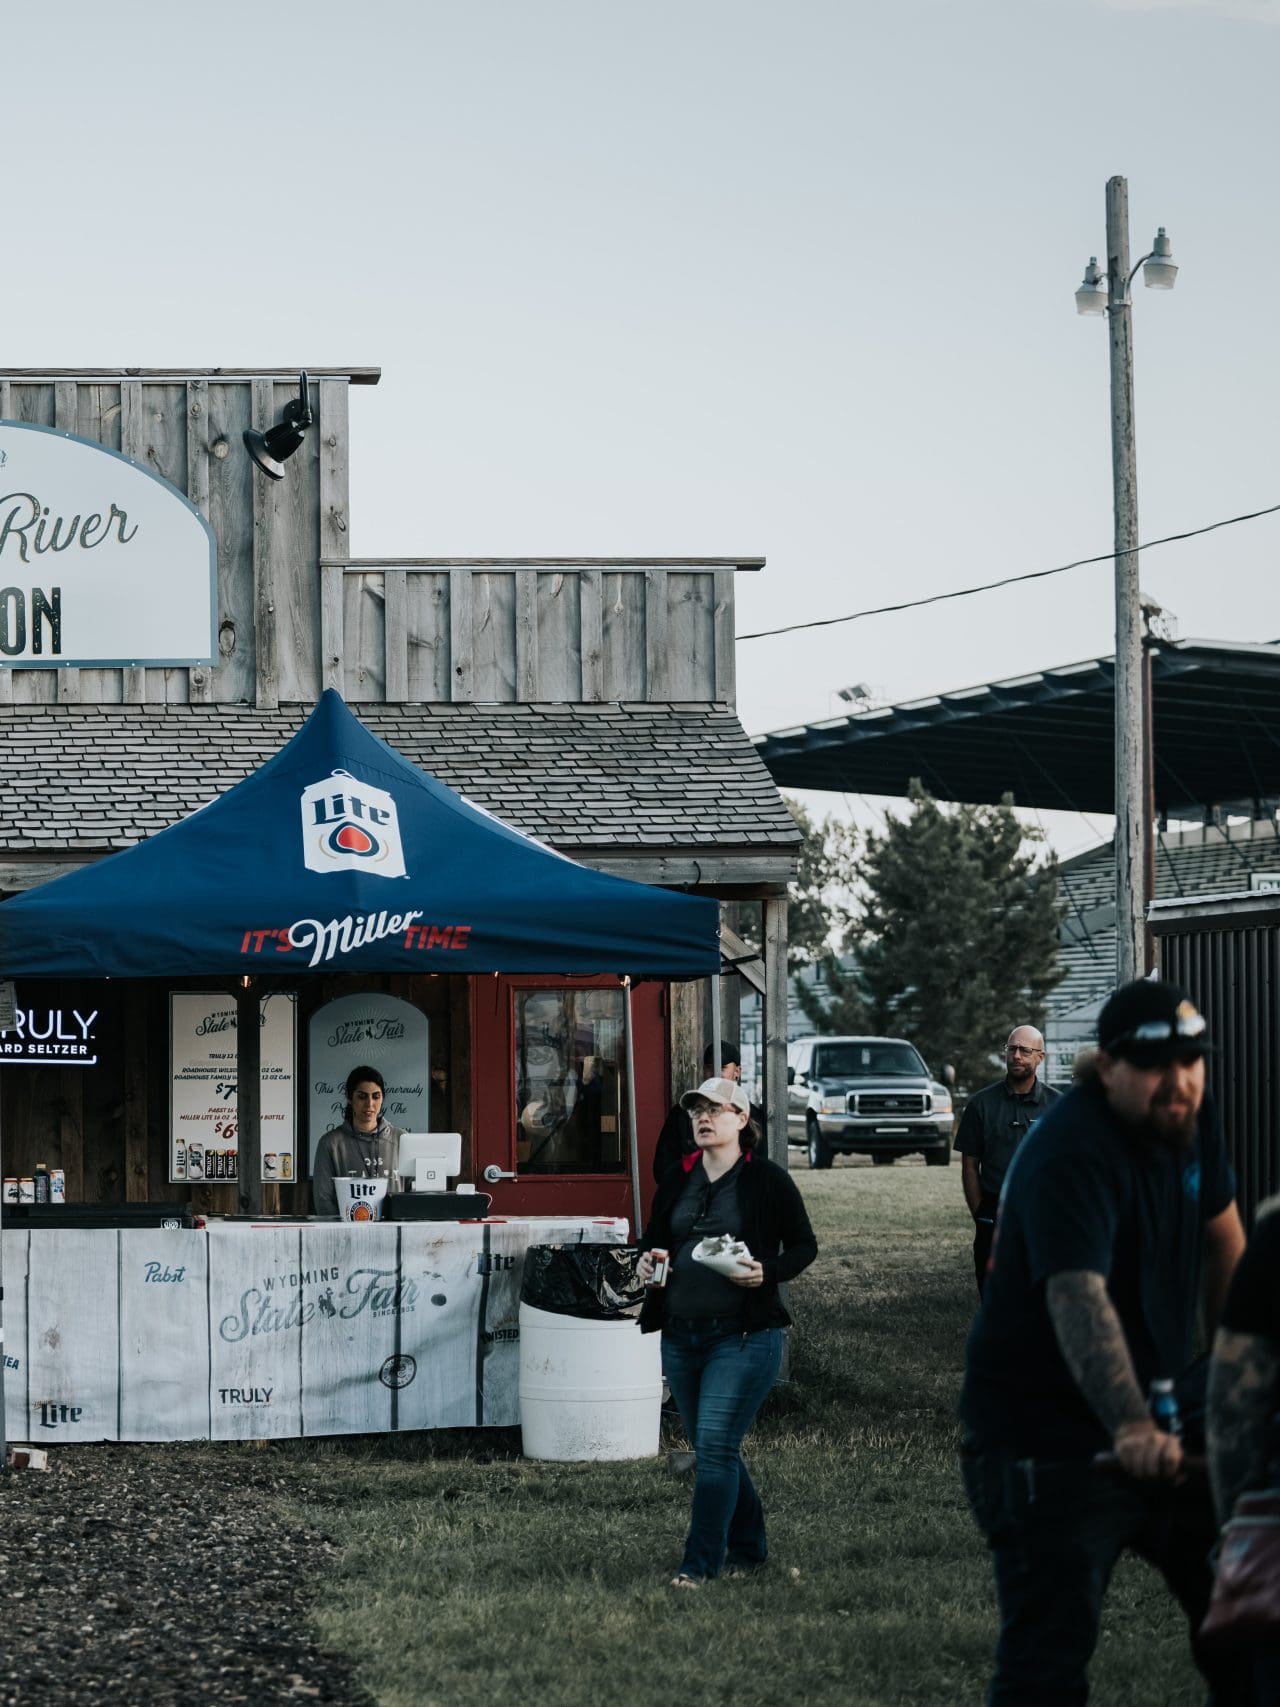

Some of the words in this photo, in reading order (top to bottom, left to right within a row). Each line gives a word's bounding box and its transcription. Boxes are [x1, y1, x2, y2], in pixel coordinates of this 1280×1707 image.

[310, 793, 391, 826] Lite
[240, 927, 295, 953] IT'S
[288, 910, 424, 968] Miller
[404, 925, 472, 949] TIME
[1, 1009, 98, 1040] RULY
[195, 1016, 230, 1036] State
[327, 1025, 365, 1047] State
[374, 1018, 406, 1040] Fair
[0, 1043, 23, 1054] ARD
[28, 1043, 88, 1055] SELTZER
[315, 1082, 334, 1095] This
[390, 1102, 408, 1114] The
[349, 1183, 377, 1199] Lite
[144, 1261, 186, 1283] Pabst
[477, 1252, 516, 1276] Lite
[263, 1267, 339, 1291] WYOMING
[219, 1287, 316, 1343] State
[339, 1264, 421, 1320] Fair
[372, 1308, 397, 1318] SINCE
[217, 1387, 274, 1404] TRULY
[39, 1402, 83, 1429] Lite
